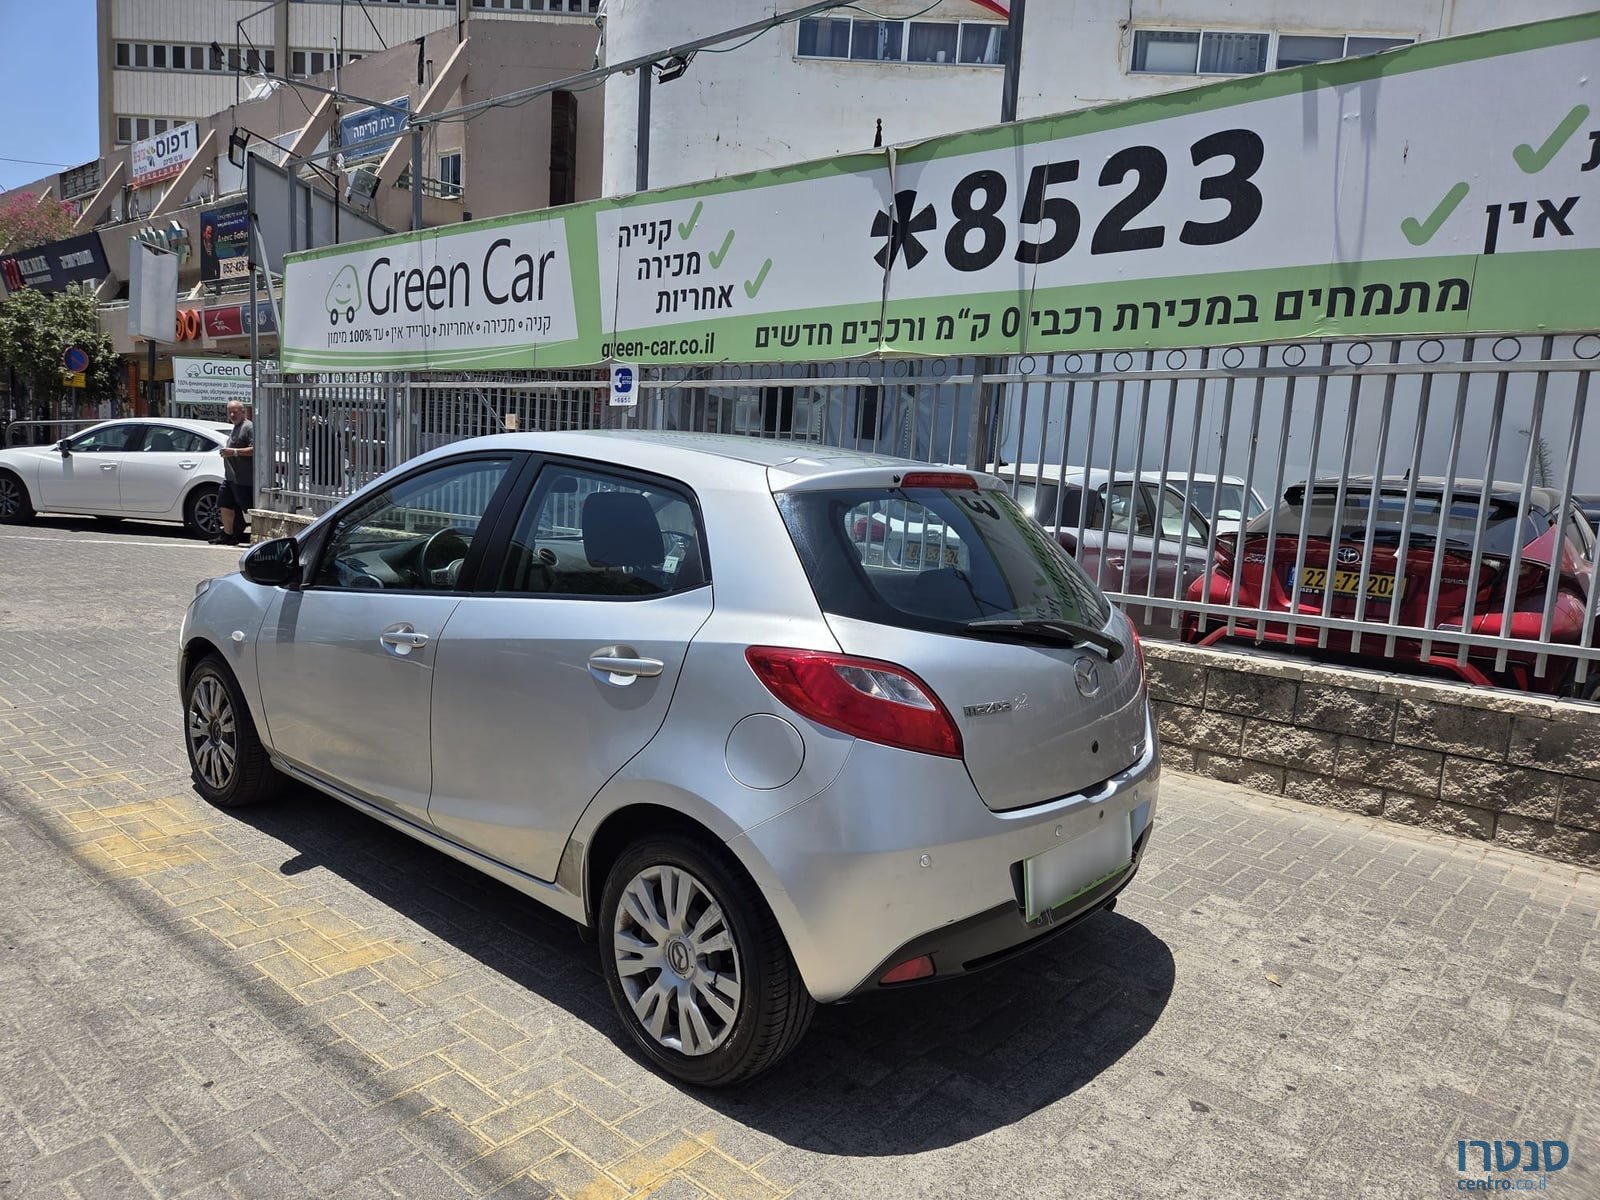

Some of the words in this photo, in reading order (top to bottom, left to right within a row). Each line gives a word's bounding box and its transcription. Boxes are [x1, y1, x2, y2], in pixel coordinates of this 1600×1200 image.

[353, 120, 378, 138] קדימה
[380, 116, 395, 130] בית
[156, 130, 190, 159] דפוס
[618, 219, 672, 250] קנייה
[1483, 195, 1581, 255] אין
[367, 257, 470, 316] Green
[482, 238, 555, 305] Car
[637, 251, 701, 280] מכירה
[655, 284, 735, 314] אחריות
[1273, 277, 1471, 322] מתמחים
[525, 315, 551, 335] קניה
[1001, 306, 1021, 338] 0
[1031, 305, 1102, 337] רכבי
[1112, 293, 1259, 332] במכירת
[327, 330, 347, 348] מימון
[349, 329, 372, 343] 100%
[373, 327, 383, 341] עד
[390, 325, 403, 343] אין
[406, 324, 431, 338] טרייד
[438, 320, 474, 337] אחריות
[482, 319, 515, 335] מכירה
[755, 323, 833, 348] חדשים
[841, 317, 926, 345] ורכבים
[203, 362, 240, 376] Green
